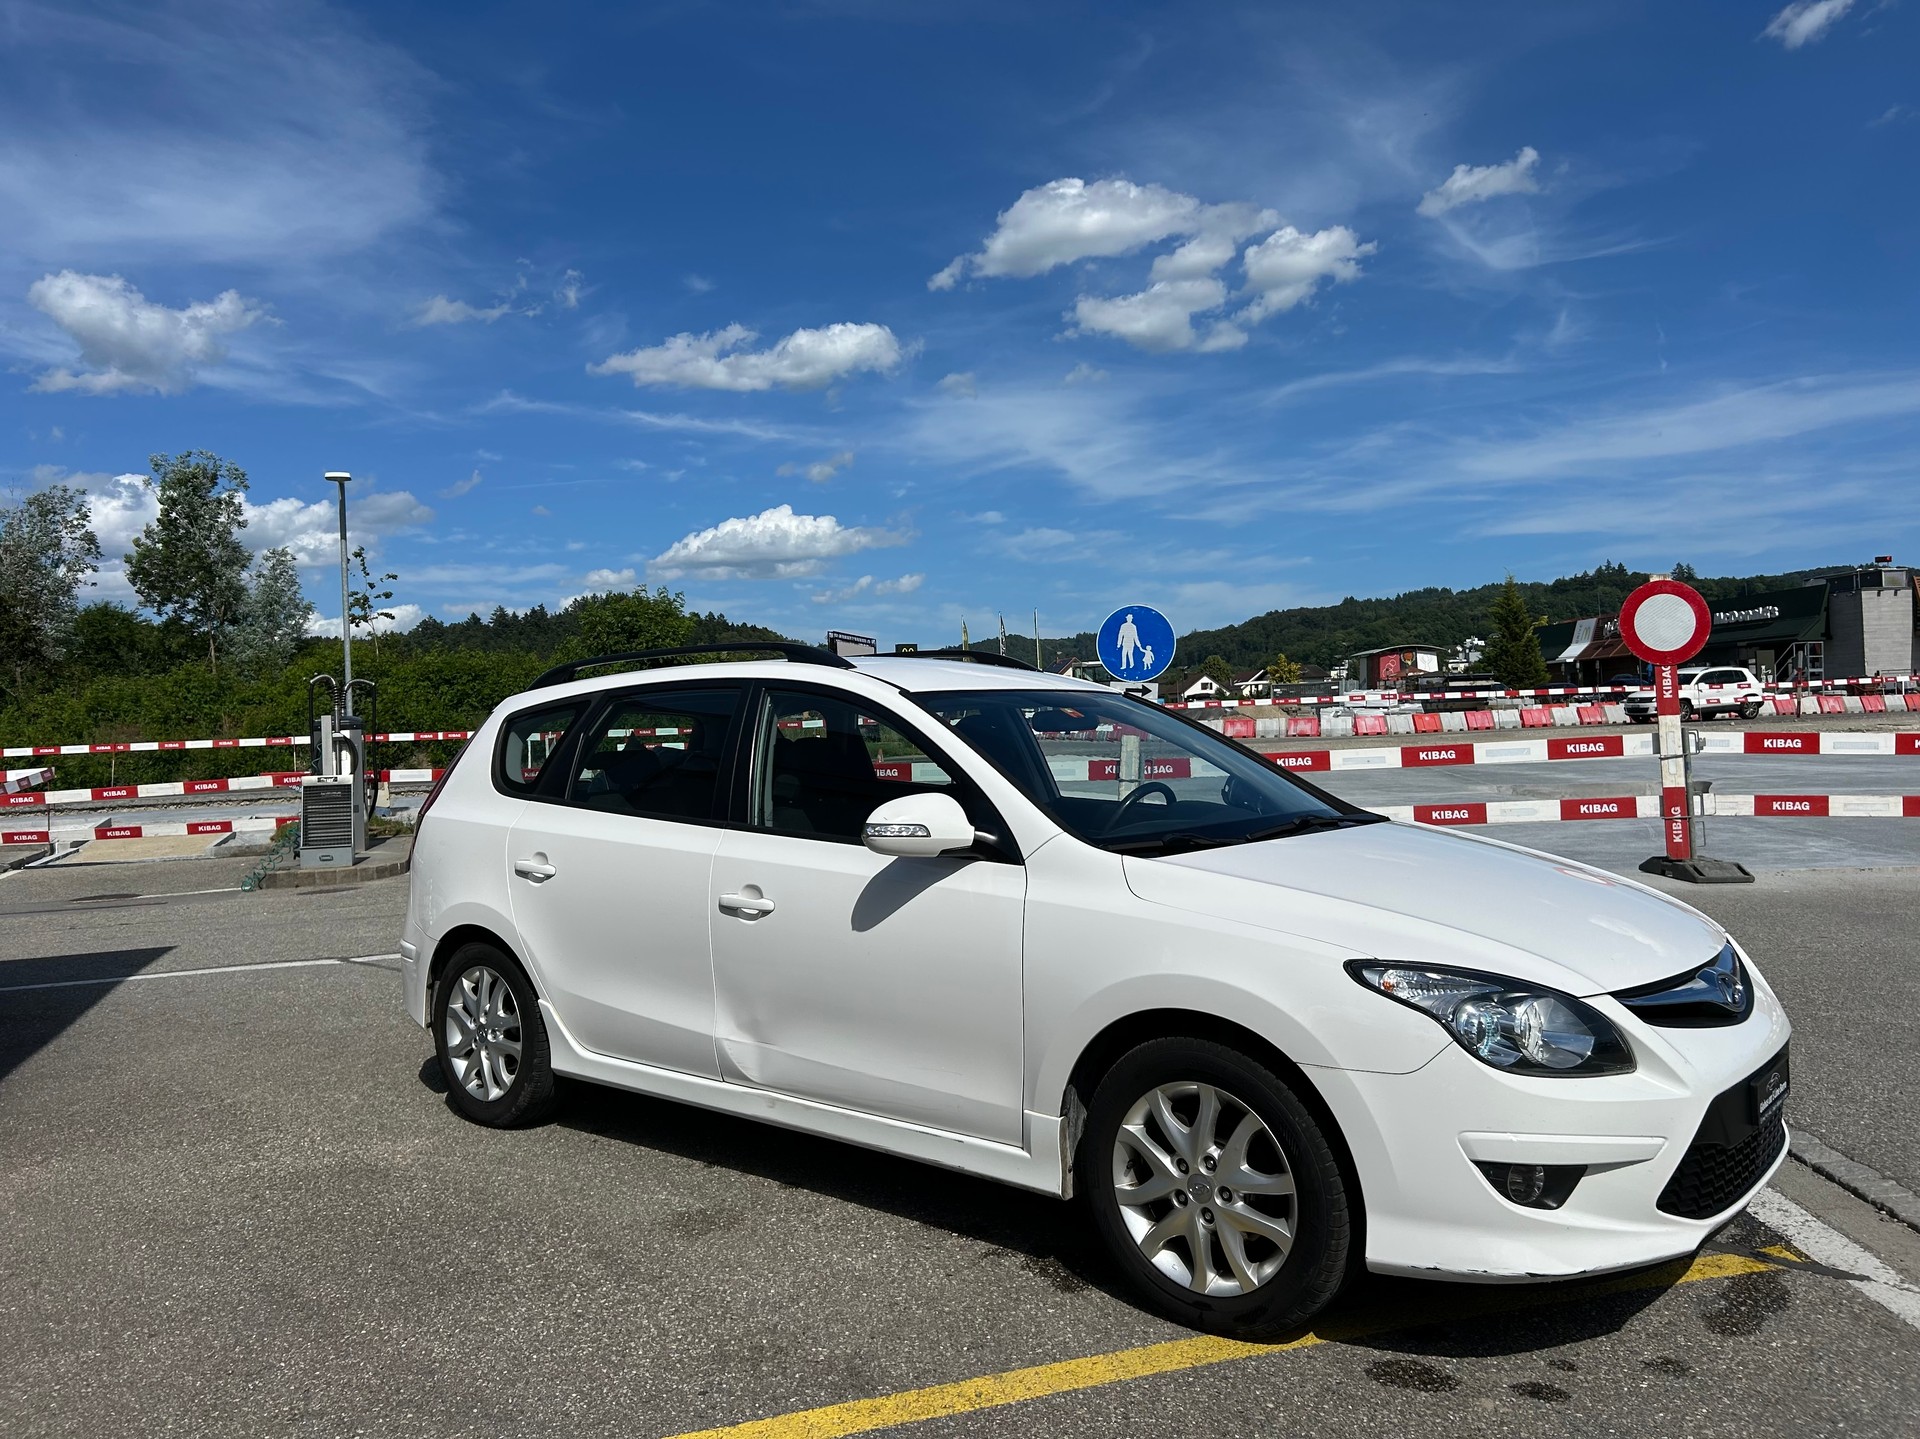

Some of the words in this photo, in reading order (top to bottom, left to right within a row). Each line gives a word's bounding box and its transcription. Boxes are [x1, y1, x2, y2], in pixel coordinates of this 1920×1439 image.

[1566, 742, 1605, 753] KIBAG
[1763, 738, 1802, 748] KIBAG
[1419, 750, 1456, 760] KIBAG
[1276, 757, 1312, 767] KIBAG
[875, 768, 898, 777] IBAG
[1580, 804, 1618, 814] KIBAG
[1772, 801, 1810, 811] KIBAG
[1431, 809, 1469, 819] KIBAG
